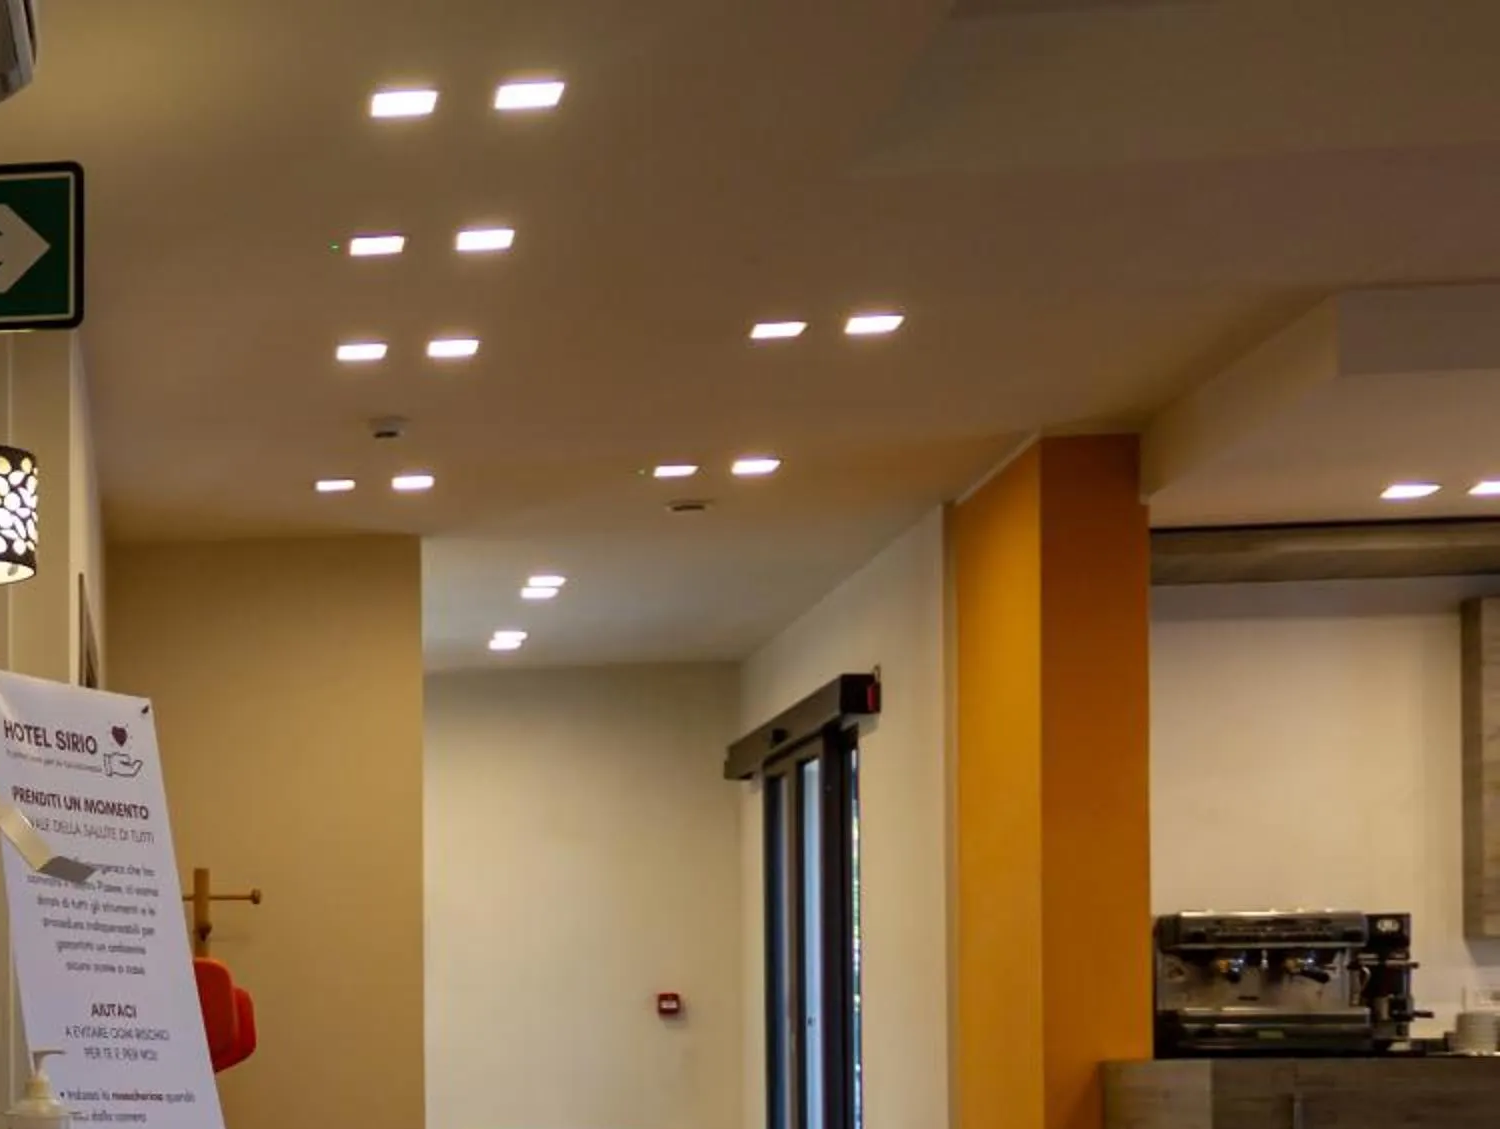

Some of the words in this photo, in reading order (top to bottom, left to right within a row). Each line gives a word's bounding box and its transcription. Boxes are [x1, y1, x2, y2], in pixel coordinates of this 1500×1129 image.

[3, 719, 52, 749] HOTEL
[55, 729, 98, 754] SIRIO
[12, 785, 62, 809] PRENDITI
[64, 794, 82, 812] UN
[84, 797, 149, 820] MOMENTO
[91, 1002, 137, 1019] AIUTACI
